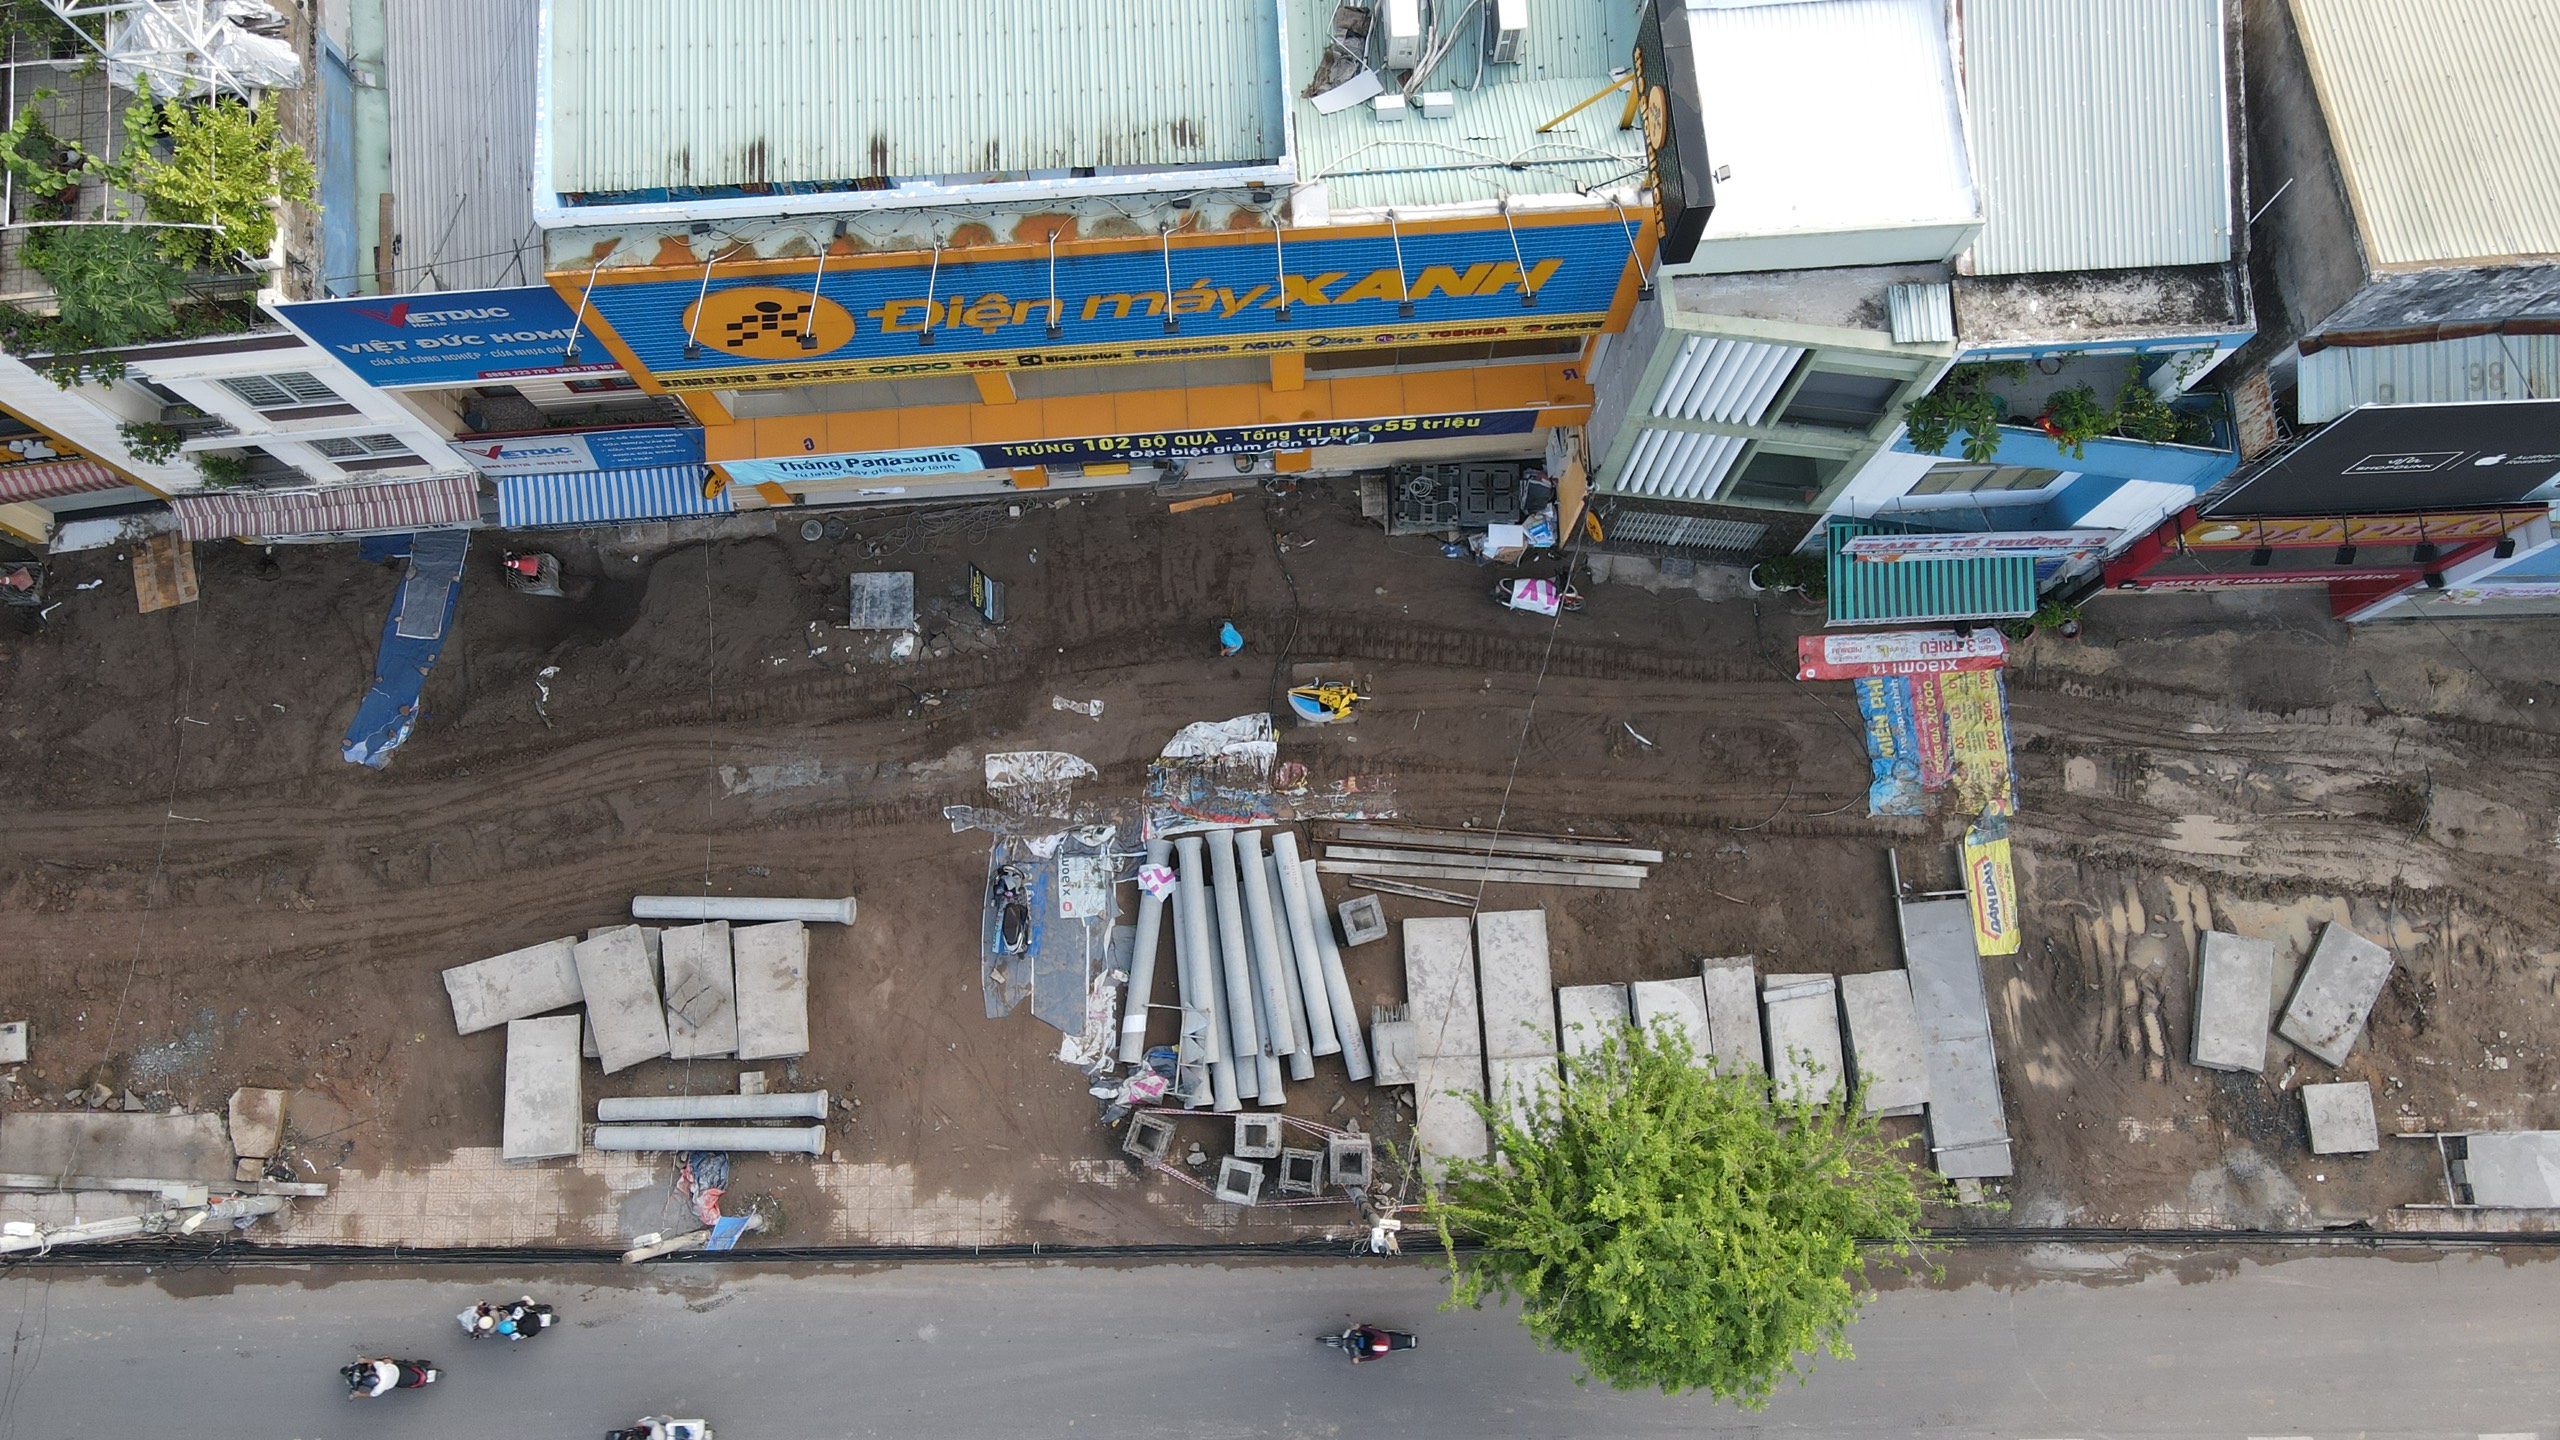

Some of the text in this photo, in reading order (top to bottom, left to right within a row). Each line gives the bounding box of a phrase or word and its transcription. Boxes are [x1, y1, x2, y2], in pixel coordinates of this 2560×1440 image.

[866, 258, 1565, 333] Điện máy XANH
[336, 327, 584, 355] VIỆT ĐỨC HOME
[1001, 442, 1076, 457] TRÚNG
[1082, 436, 1132, 452] 102
[1138, 434, 1167, 449] BỘ
[1174, 431, 1219, 446] QUÀ
[1240, 428, 1291, 442] Tổng
[1421, 416, 1481, 431] triệu
[1129, 448, 1167, 458] Đặc
[1170, 446, 1209, 457] biệt
[775, 452, 961, 473] Tháng Panasonic
[1949, 536, 1984, 548] TẾ
[1984, 534, 2073, 547] PHƯỜNG
[2150, 580, 2193, 588] CAM
[1919, 638, 1976, 657] 3 TRIỆU
[1871, 660, 1959, 676] xiaomi 14
